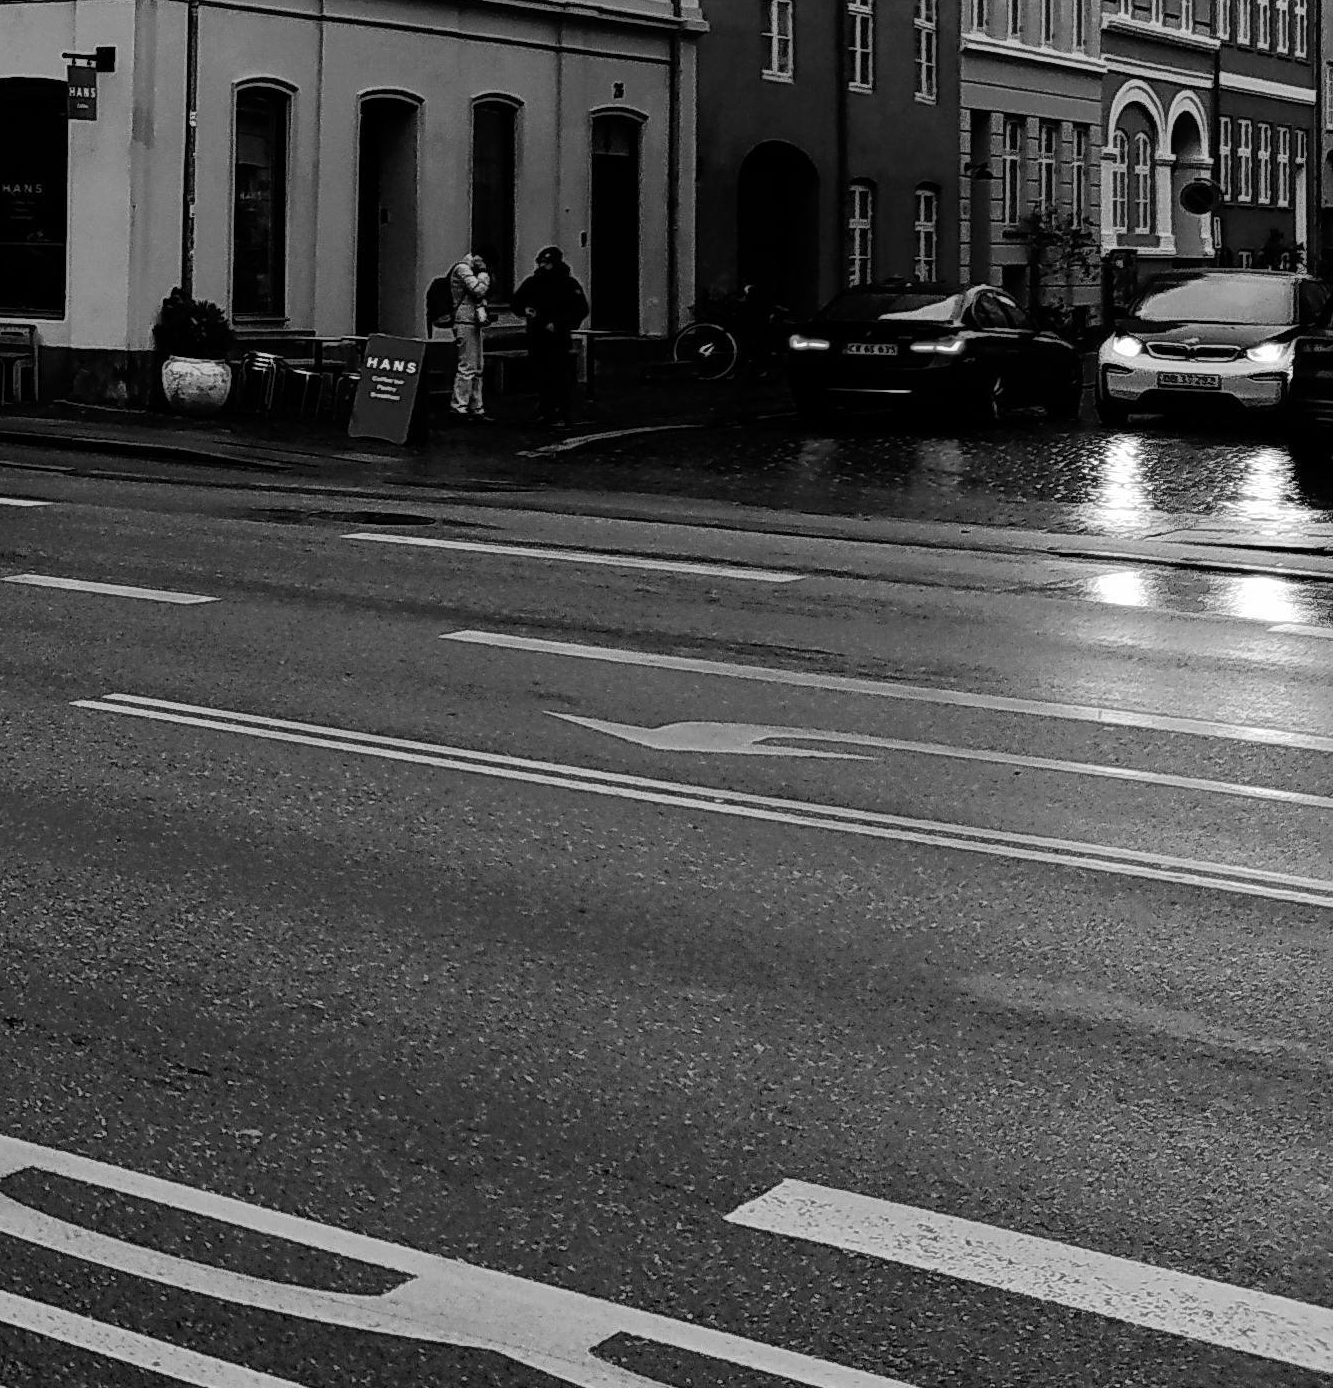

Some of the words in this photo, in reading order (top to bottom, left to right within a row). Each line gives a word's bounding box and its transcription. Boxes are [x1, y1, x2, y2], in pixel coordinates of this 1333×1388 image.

[68, 86, 96, 98] HANS
[2, 183, 43, 194] HANS
[366, 356, 417, 374] HANS
